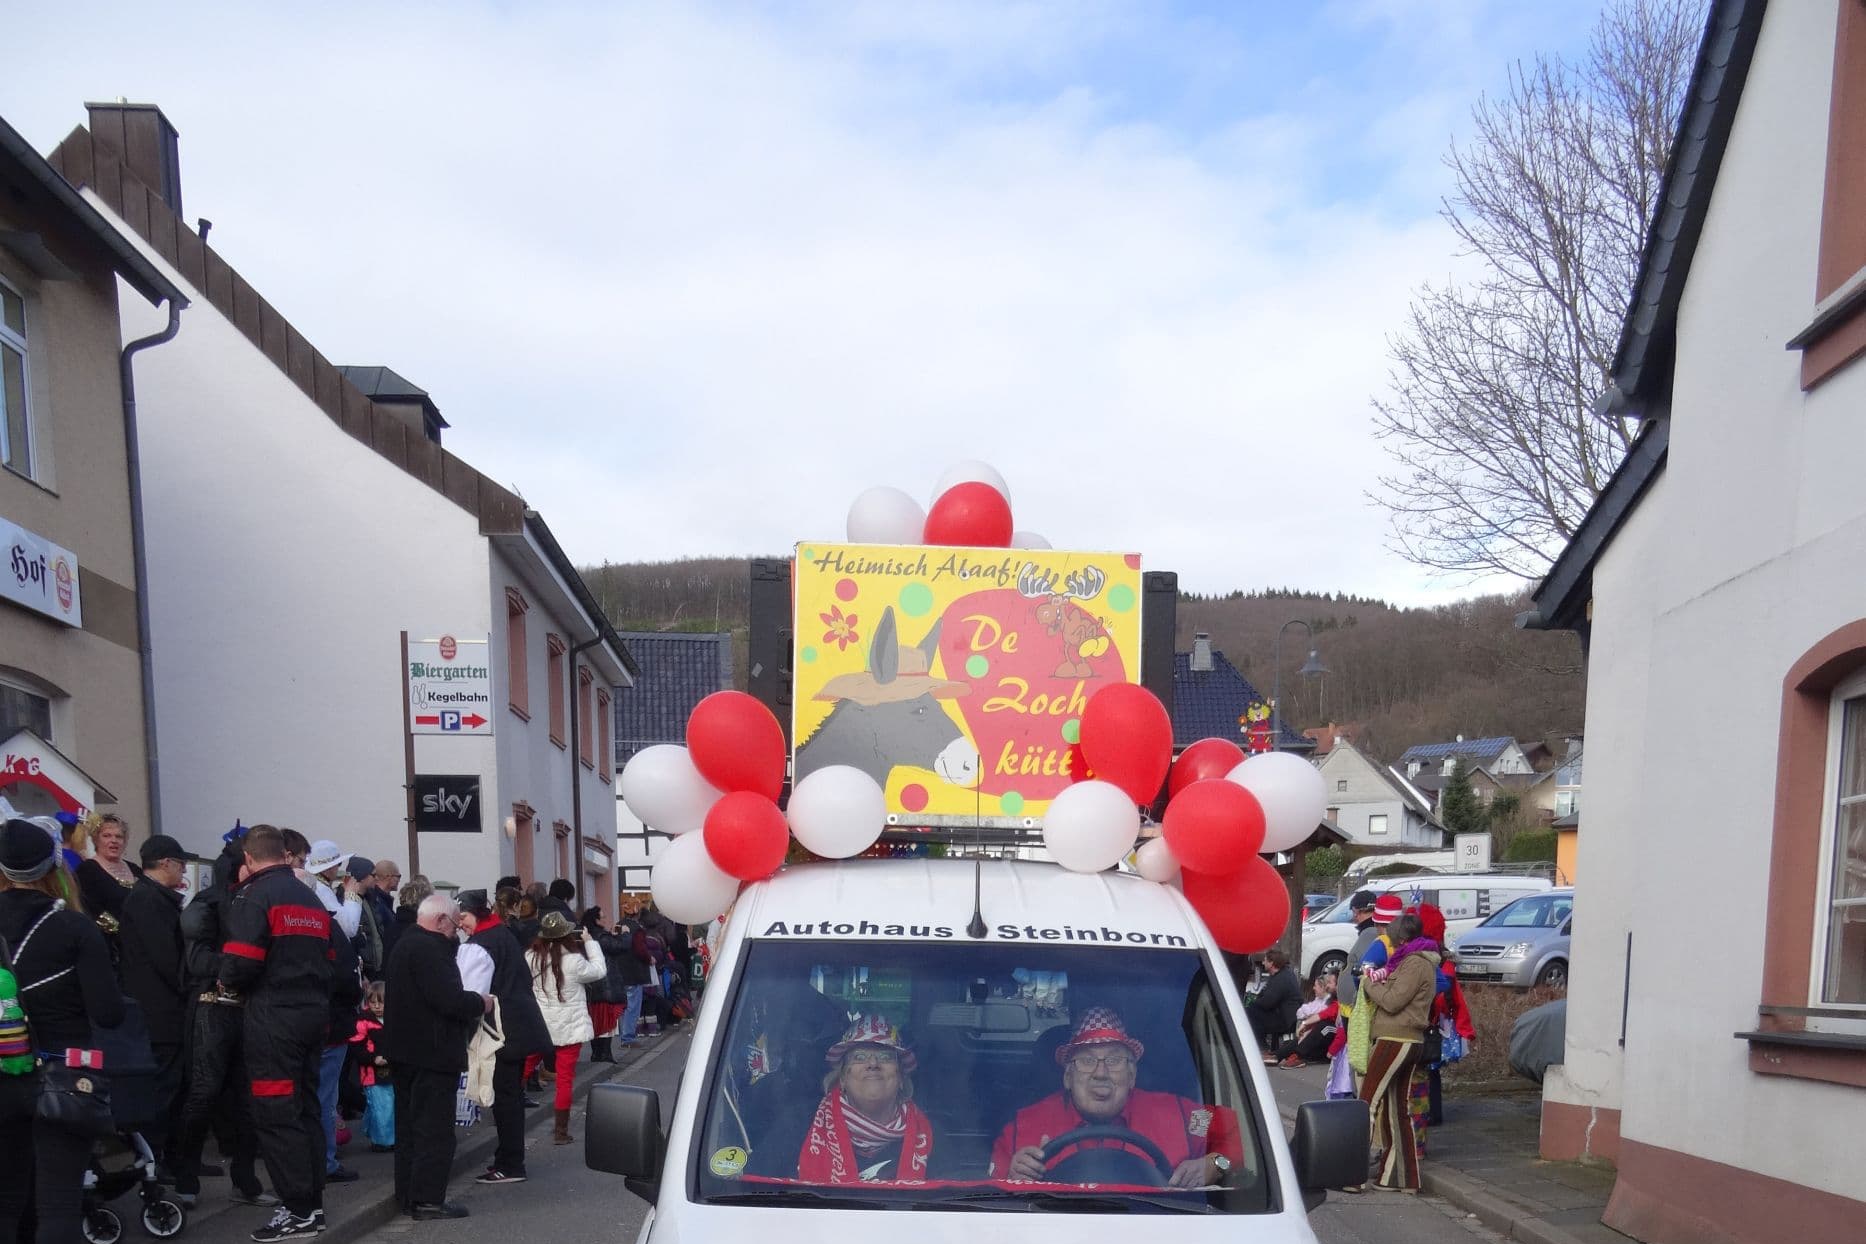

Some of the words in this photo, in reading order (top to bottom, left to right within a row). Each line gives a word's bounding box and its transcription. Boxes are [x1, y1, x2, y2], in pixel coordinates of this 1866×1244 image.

[11, 544, 46, 600] Hof
[813, 551, 927, 576] Heimisch
[931, 553, 1021, 587] Alaaf!
[961, 614, 1019, 653] De
[410, 662, 487, 681] Biergarten
[428, 692, 488, 703] Kegelbahn
[423, 787, 472, 819] sky
[1466, 845, 1479, 856] 30
[763, 919, 954, 939] Autohaus
[997, 923, 1188, 947] Steinborn
[726, 1149, 737, 1161] 3
